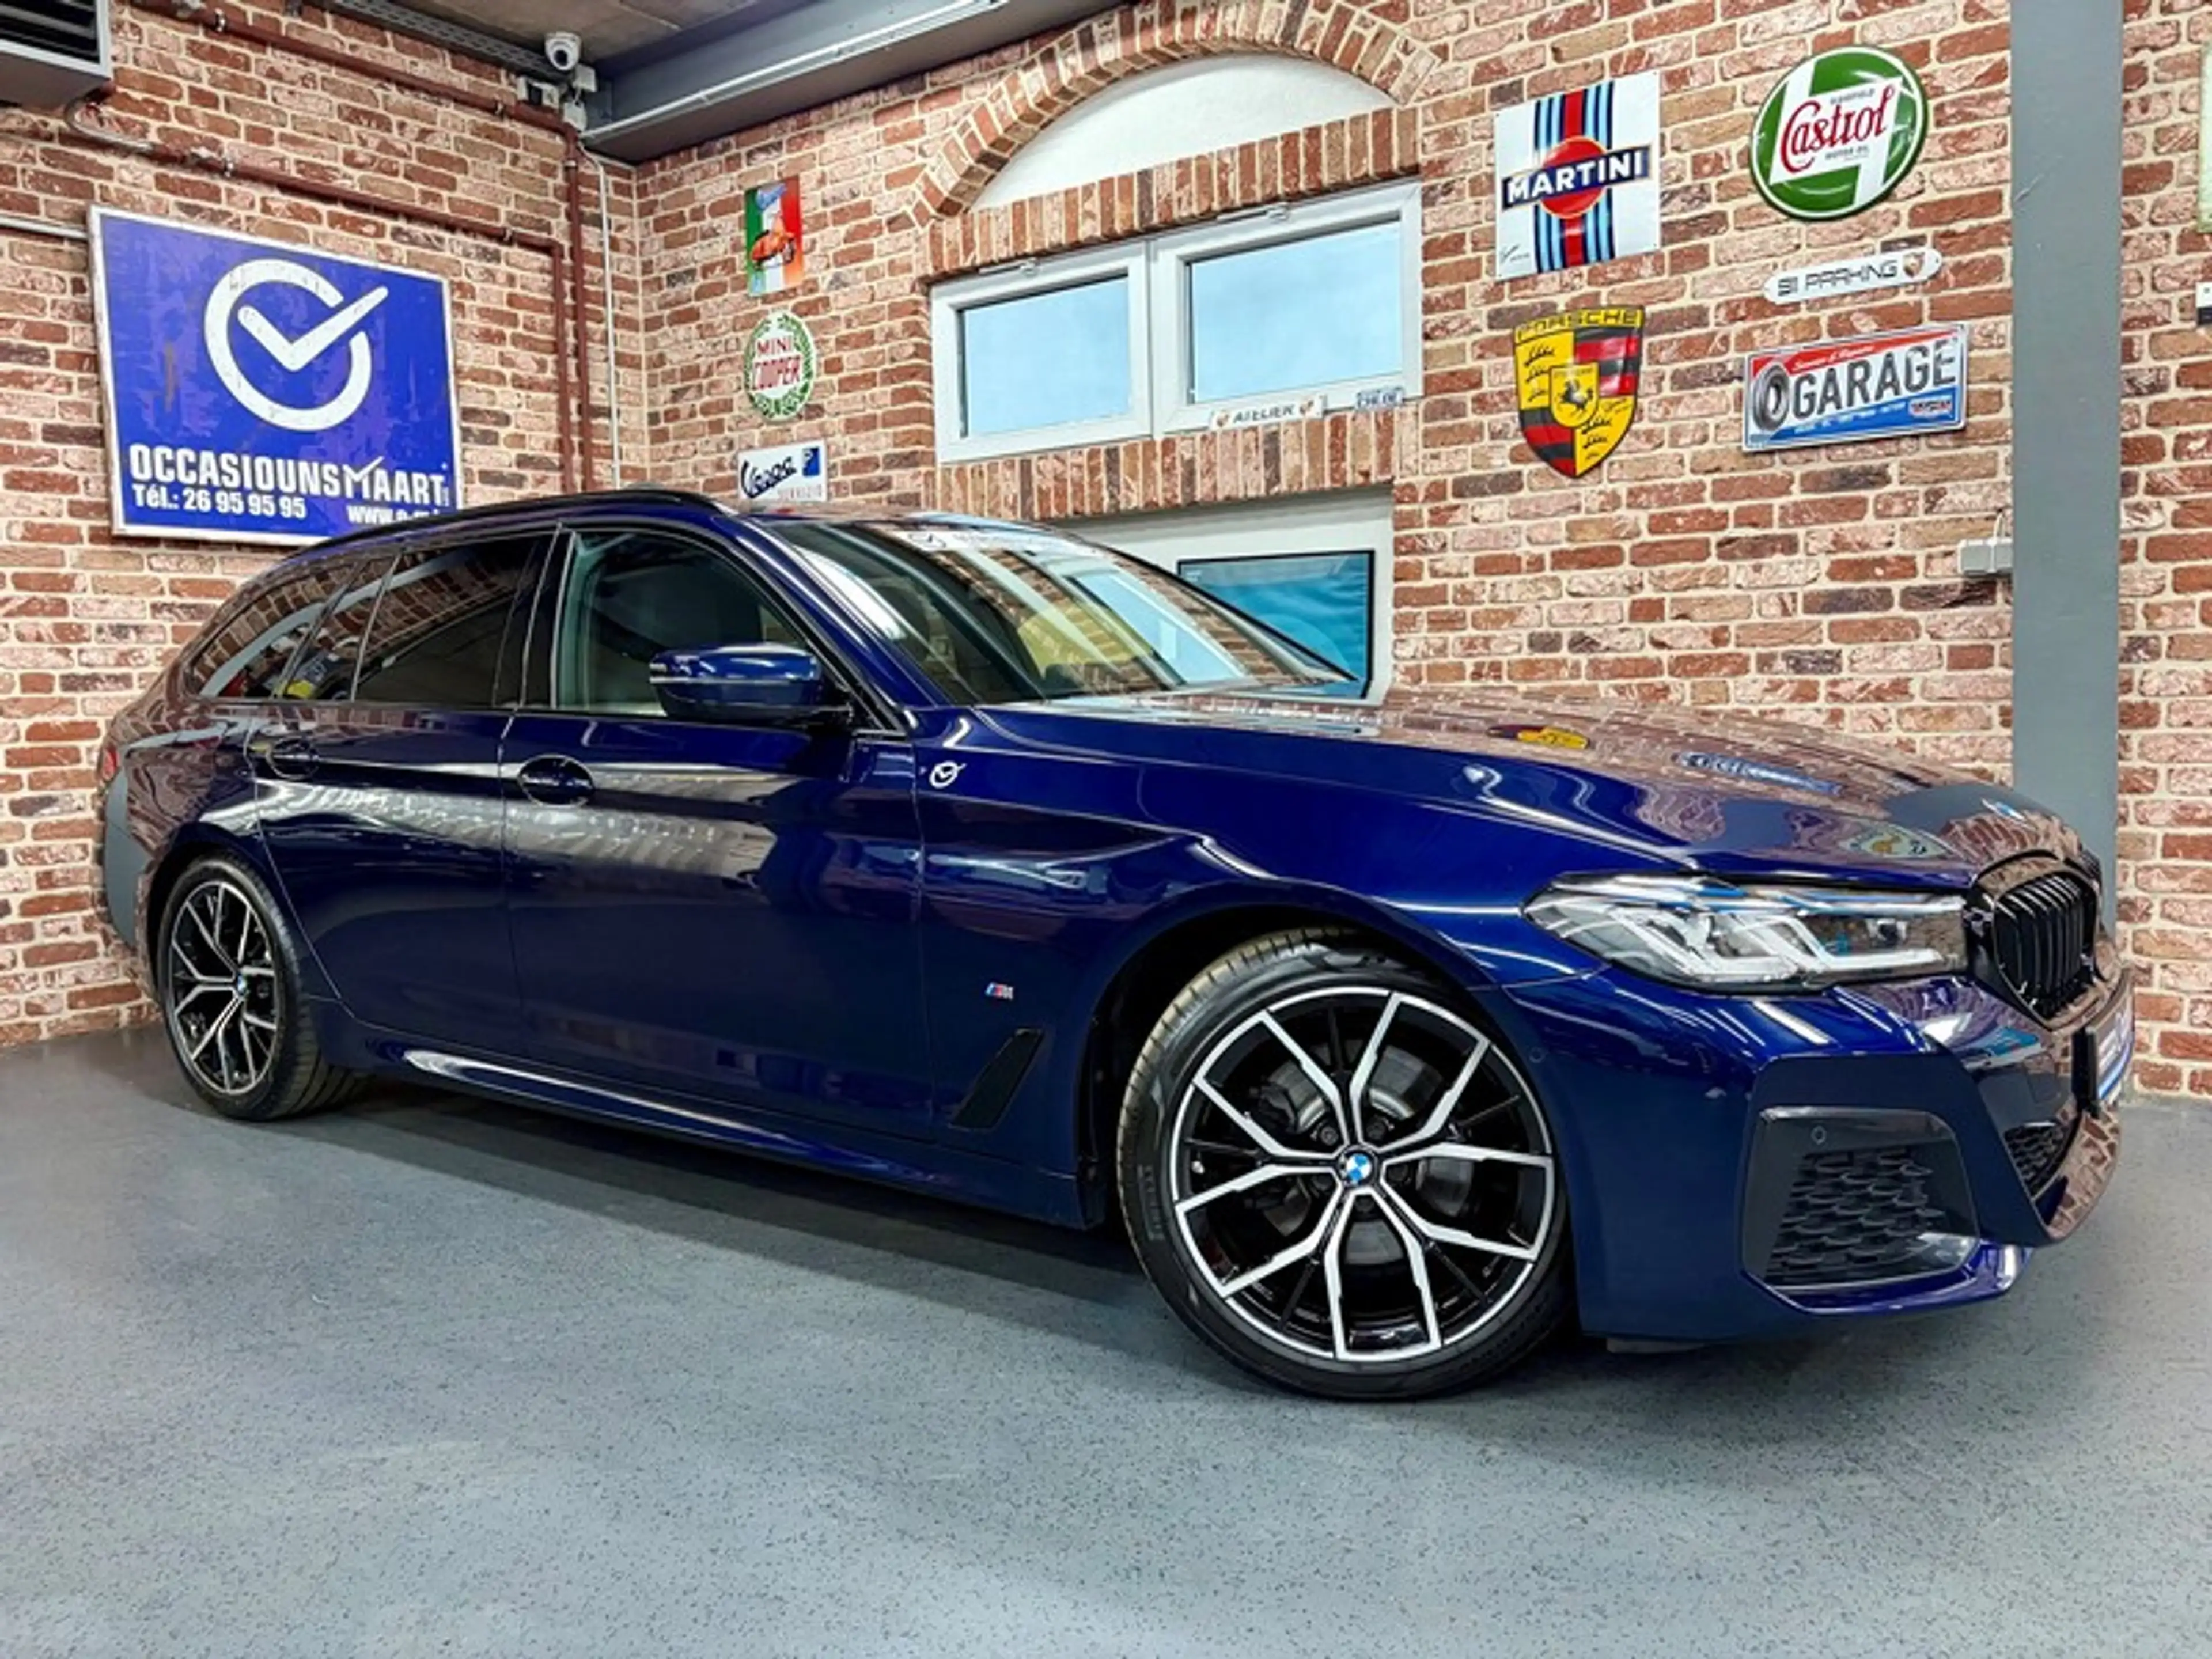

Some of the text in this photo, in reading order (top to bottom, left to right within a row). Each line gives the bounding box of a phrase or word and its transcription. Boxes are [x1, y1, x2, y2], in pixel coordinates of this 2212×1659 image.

[1781, 85, 1895, 174] Castrol
[1507, 151, 1642, 203] MARTINI
[1805, 260, 1899, 291] PARKING
[757, 336, 793, 356] MINI
[1516, 309, 1642, 344] PORSCHE
[1791, 338, 1956, 420] GARAGE
[1233, 403, 1295, 424] ATELIER
[128, 443, 445, 506] OCCASIOUNSMAART
[741, 456, 797, 499] Vespa
[182, 488, 211, 513] 26
[216, 491, 244, 514] 95
[248, 494, 276, 517] 95
[280, 497, 307, 520] 95
